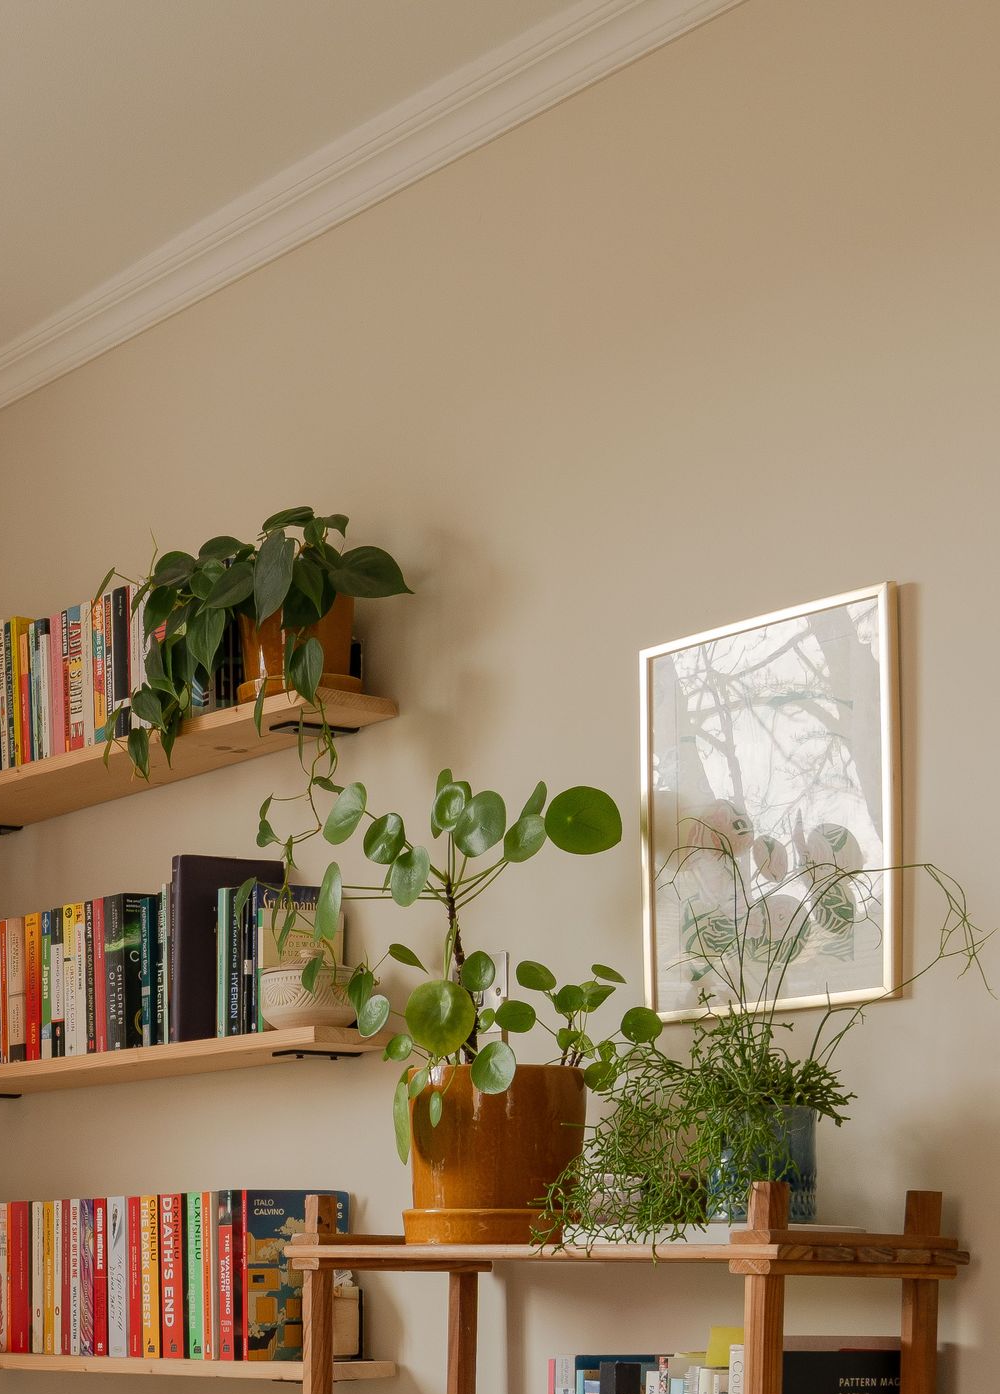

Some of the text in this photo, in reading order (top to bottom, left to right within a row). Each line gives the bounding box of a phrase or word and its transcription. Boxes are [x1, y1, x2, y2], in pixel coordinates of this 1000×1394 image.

[6, 670, 12, 678] TO
[70, 620, 82, 714] ZADIE SMITH
[42, 964, 50, 999] Japan
[109, 972, 115, 986] OF
[156, 984, 164, 1024] Beatles
[254, 1208, 284, 1216] CALVINO
[142, 1232, 150, 1268] DARK
[72, 1258, 78, 1267] ON
[162, 1197, 174, 1327] DEATH'S END
[72, 1268, 78, 1278] ME
[840, 1378, 877, 1387] PATTERN
